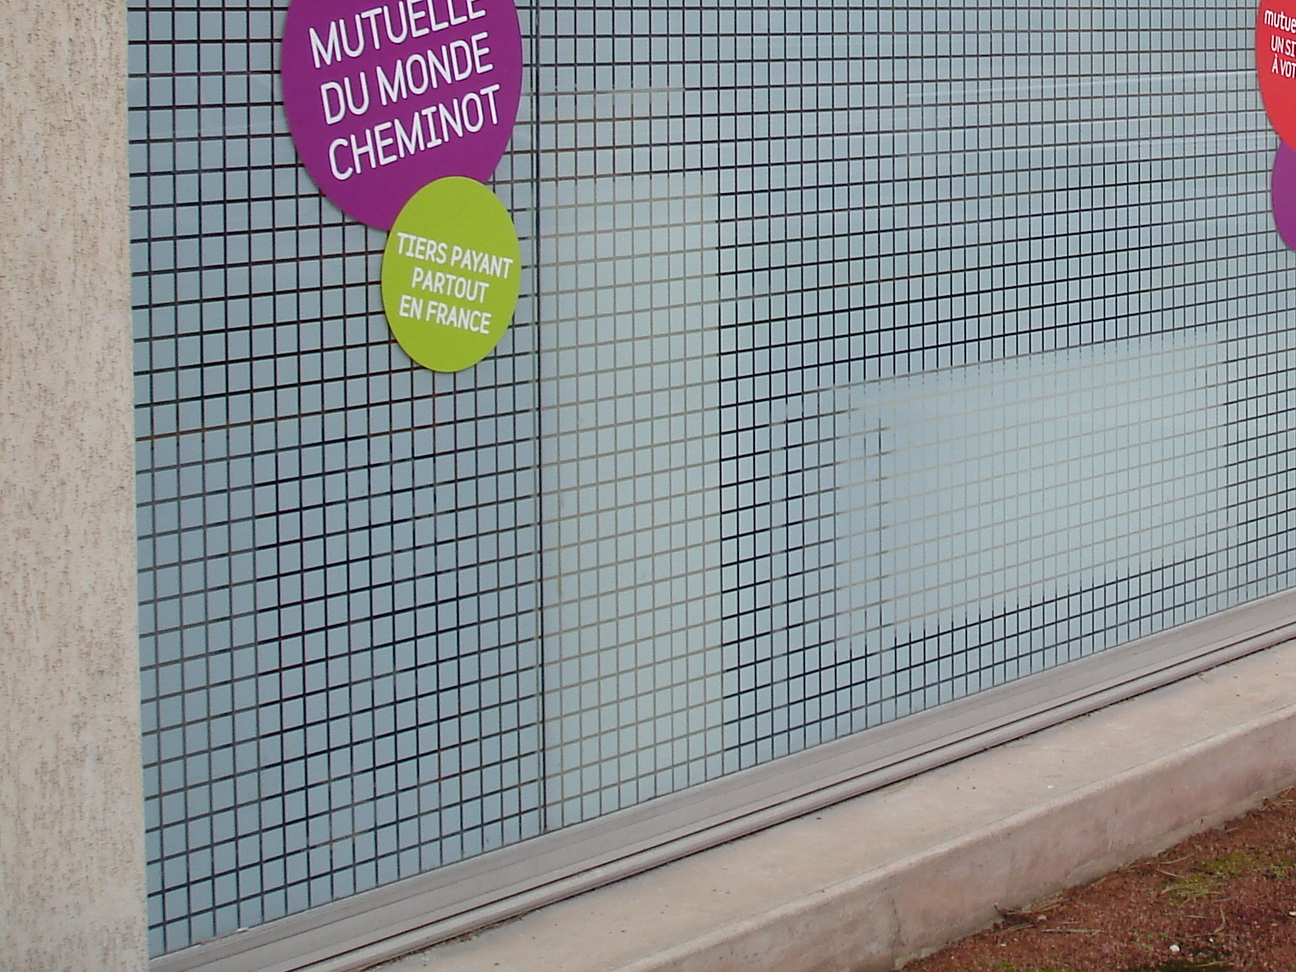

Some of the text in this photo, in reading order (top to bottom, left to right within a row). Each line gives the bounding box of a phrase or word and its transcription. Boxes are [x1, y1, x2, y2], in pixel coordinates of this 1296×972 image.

[1271, 35, 1284, 54] UN
[1271, 53, 1279, 74] À
[320, 31, 494, 125] DU MONDE
[328, 84, 500, 181] CHEMINOT
[397, 232, 514, 280] TIERS PAYANT
[411, 266, 490, 304] PARTOUT
[399, 294, 492, 335] EN FRANCE
